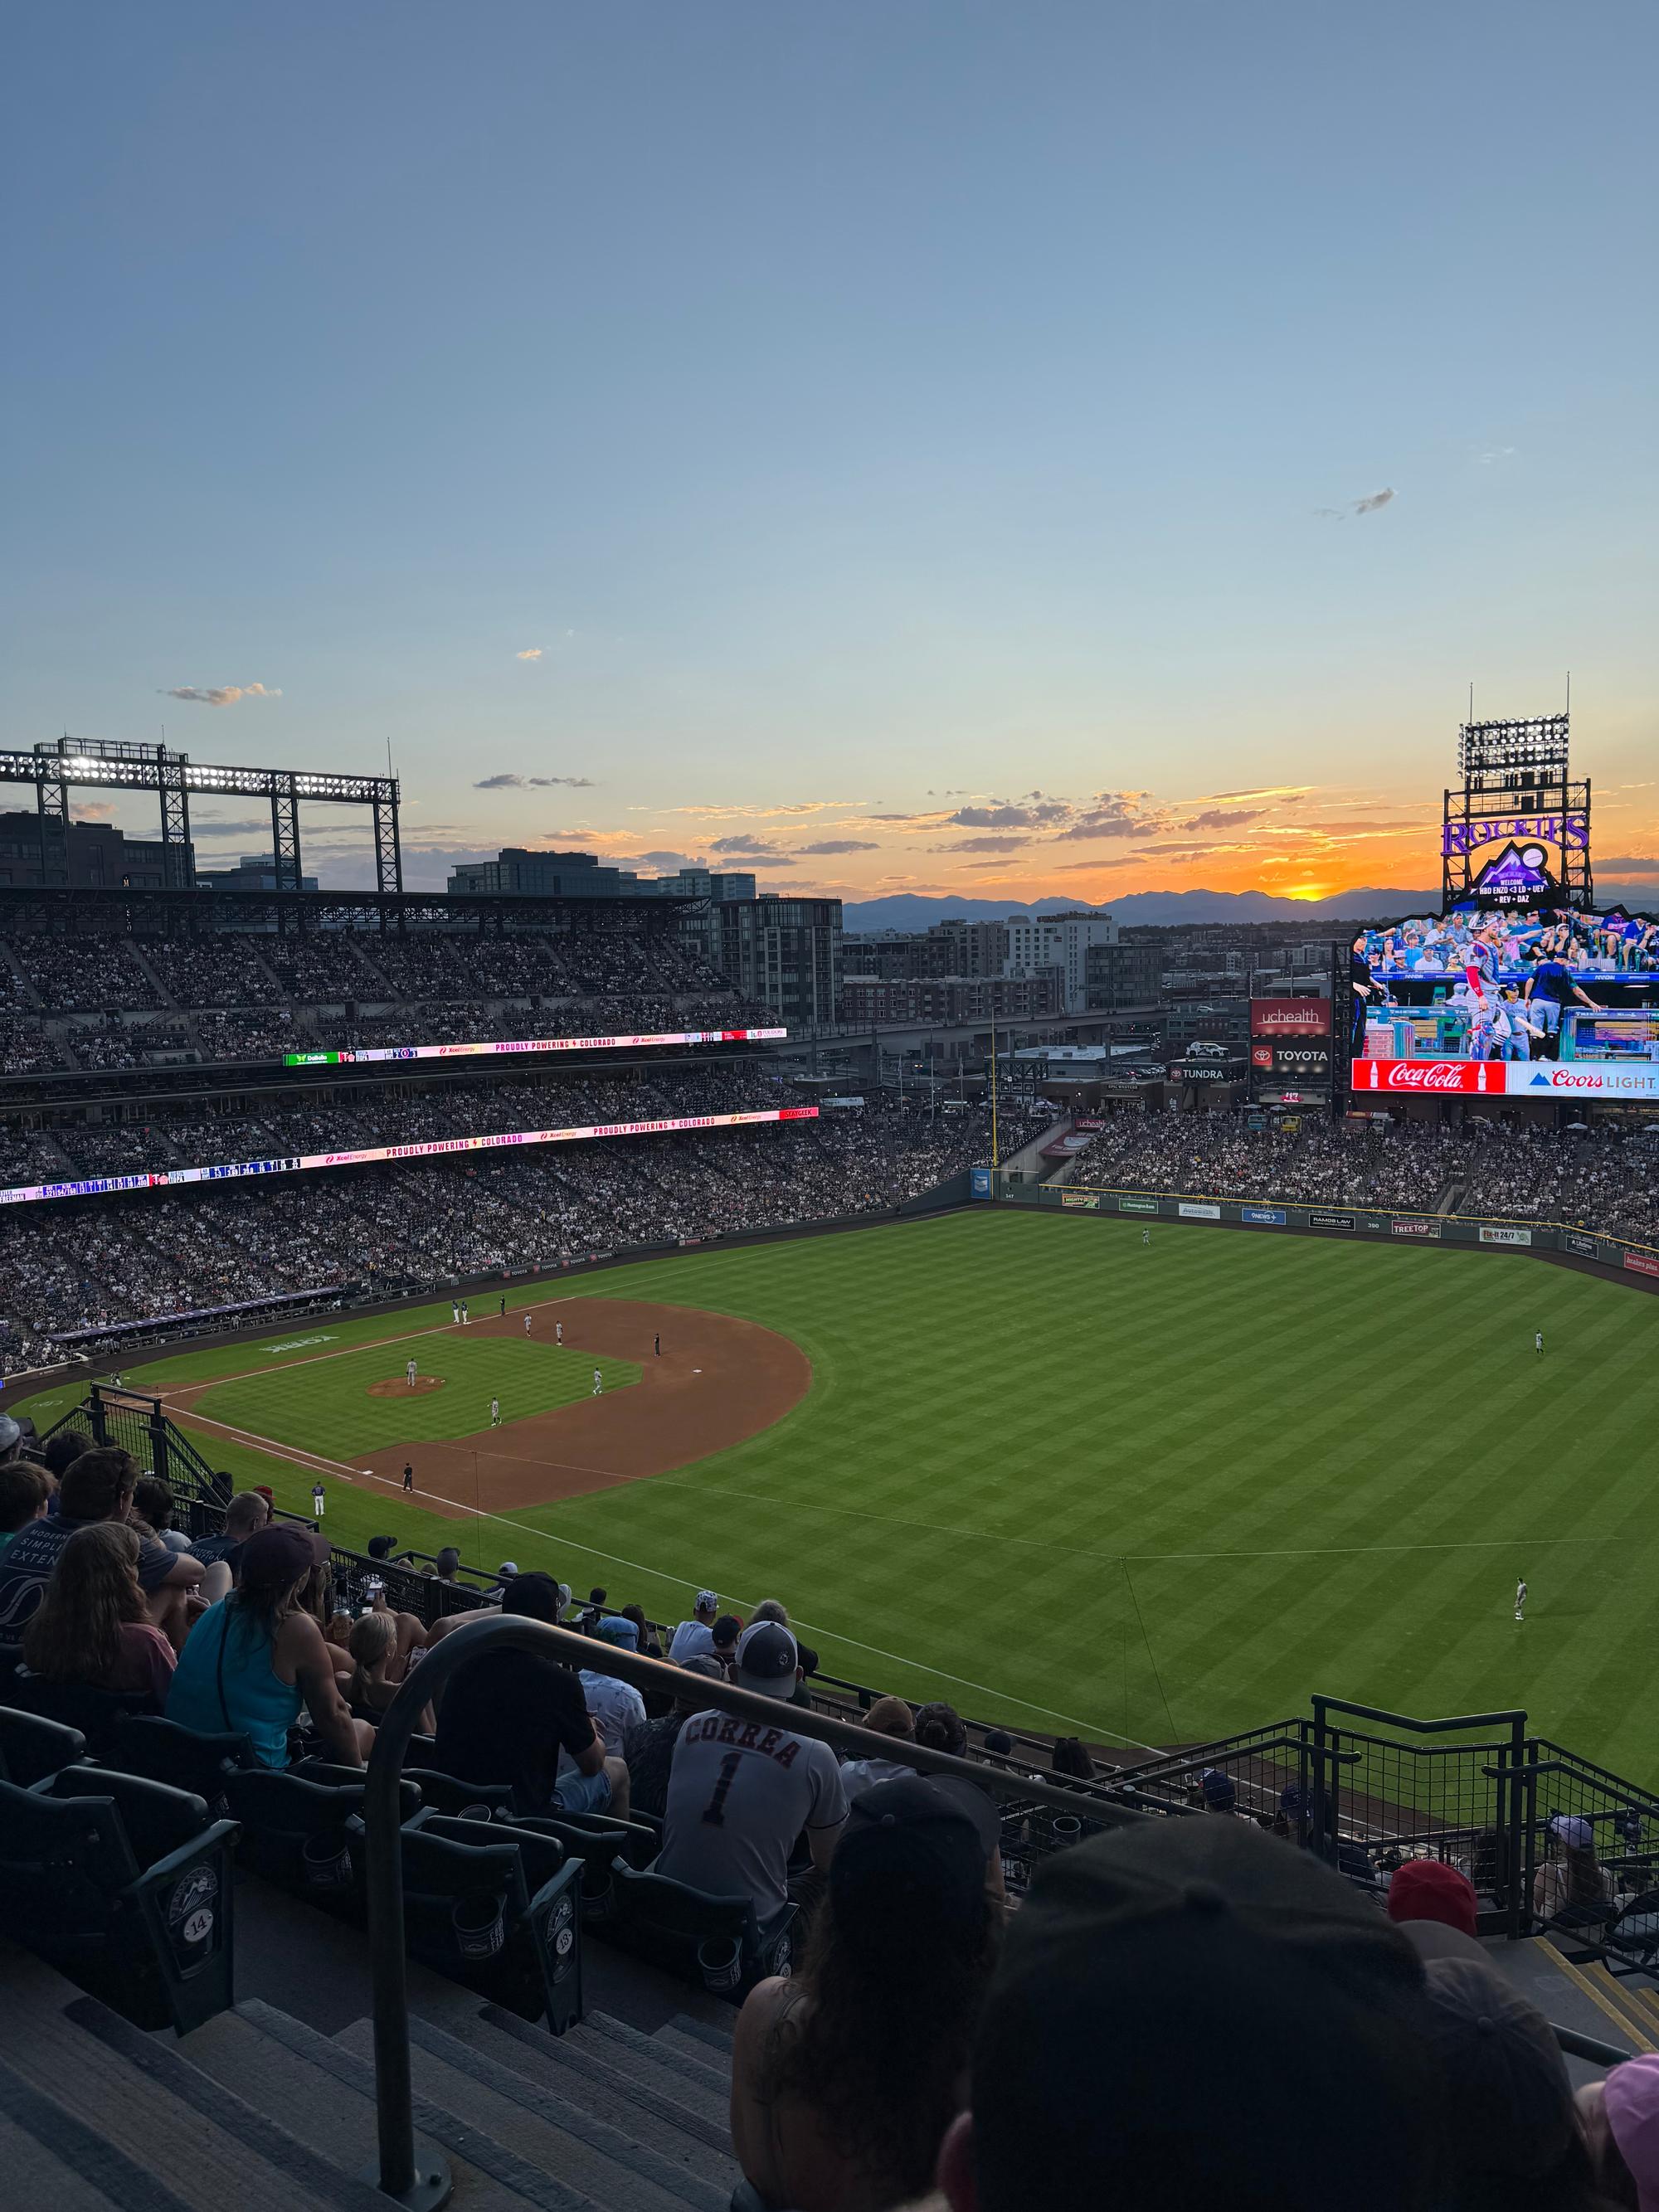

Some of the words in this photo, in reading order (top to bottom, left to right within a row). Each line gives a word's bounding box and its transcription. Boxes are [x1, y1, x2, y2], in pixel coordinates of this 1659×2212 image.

[1441, 816, 1588, 855] ROCKIES
[1262, 1009, 1319, 1023] uchealth
[495, 1043, 528, 1052] PROUDLY
[532, 1040, 569, 1050] POWERING
[580, 1038, 615, 1048] COLORADO
[1277, 1051, 1327, 1061] TOYOTA
[1183, 1069, 1224, 1079] TUNDRA
[1389, 1062, 1467, 1088] Coca-Cola
[1552, 1070, 1603, 1088] Coors
[1607, 1077, 1656, 1088] LIGHT
[785, 1109, 812, 1117] SEATGEEK
[594, 1125, 627, 1135] PROUDLY
[630, 1121, 668, 1132] POWERING
[679, 1117, 715, 1128] COLORADO
[387, 1145, 424, 1158] PROUDLY
[427, 1140, 469, 1153] POWERING
[481, 1135, 523, 1146] COLORADO
[349, 1153, 367, 1161] Energy
[30, 1529, 67, 1540] MODERN
[685, 1716, 801, 1770] CORREA
[703, 1752, 743, 1828] 1
[191, 1915, 207, 1936] 14
